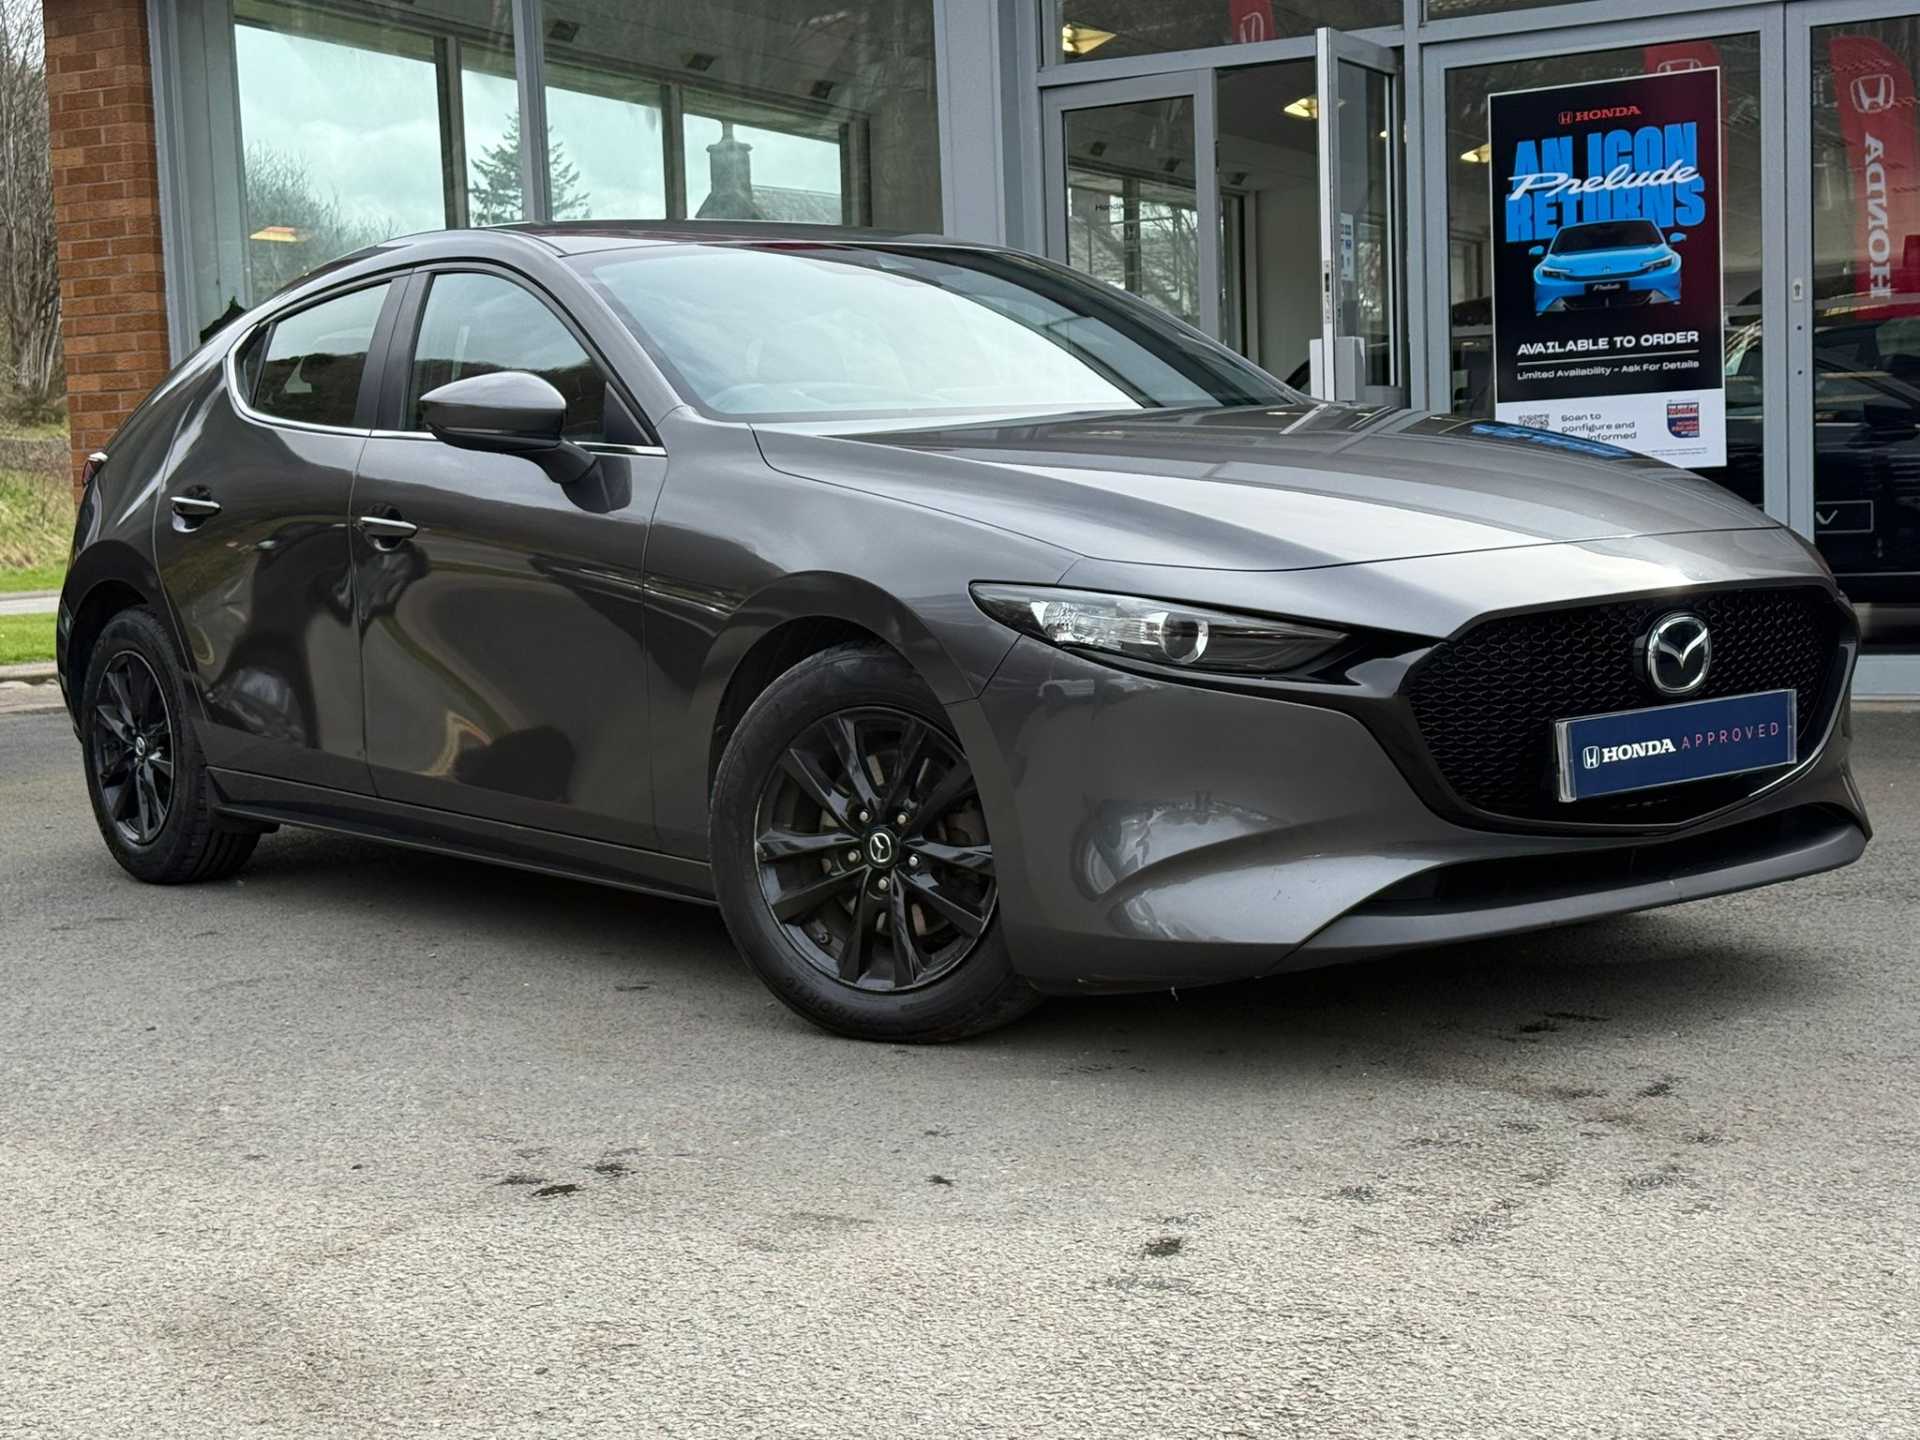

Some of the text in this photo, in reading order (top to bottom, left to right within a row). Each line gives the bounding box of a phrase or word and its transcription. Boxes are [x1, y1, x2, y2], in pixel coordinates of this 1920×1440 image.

[1575, 105, 1641, 121] HONDA
[1512, 121, 1697, 190] AN ICON
[1507, 159, 1701, 201] Prelude
[1505, 175, 1706, 243] RETURNS
[1517, 330, 1699, 355] AVAILABLE TO ORDER
[1516, 370, 1554, 381] Limited
[1556, 365, 1612, 379] Availability
[1621, 363, 1641, 374] Ask
[1642, 362, 1661, 372] For
[1662, 360, 1700, 371] Details
[1560, 412, 1602, 423] Scan to
[1561, 420, 1636, 434] configure and
[1602, 723, 1779, 763] HONDA APPROVED
